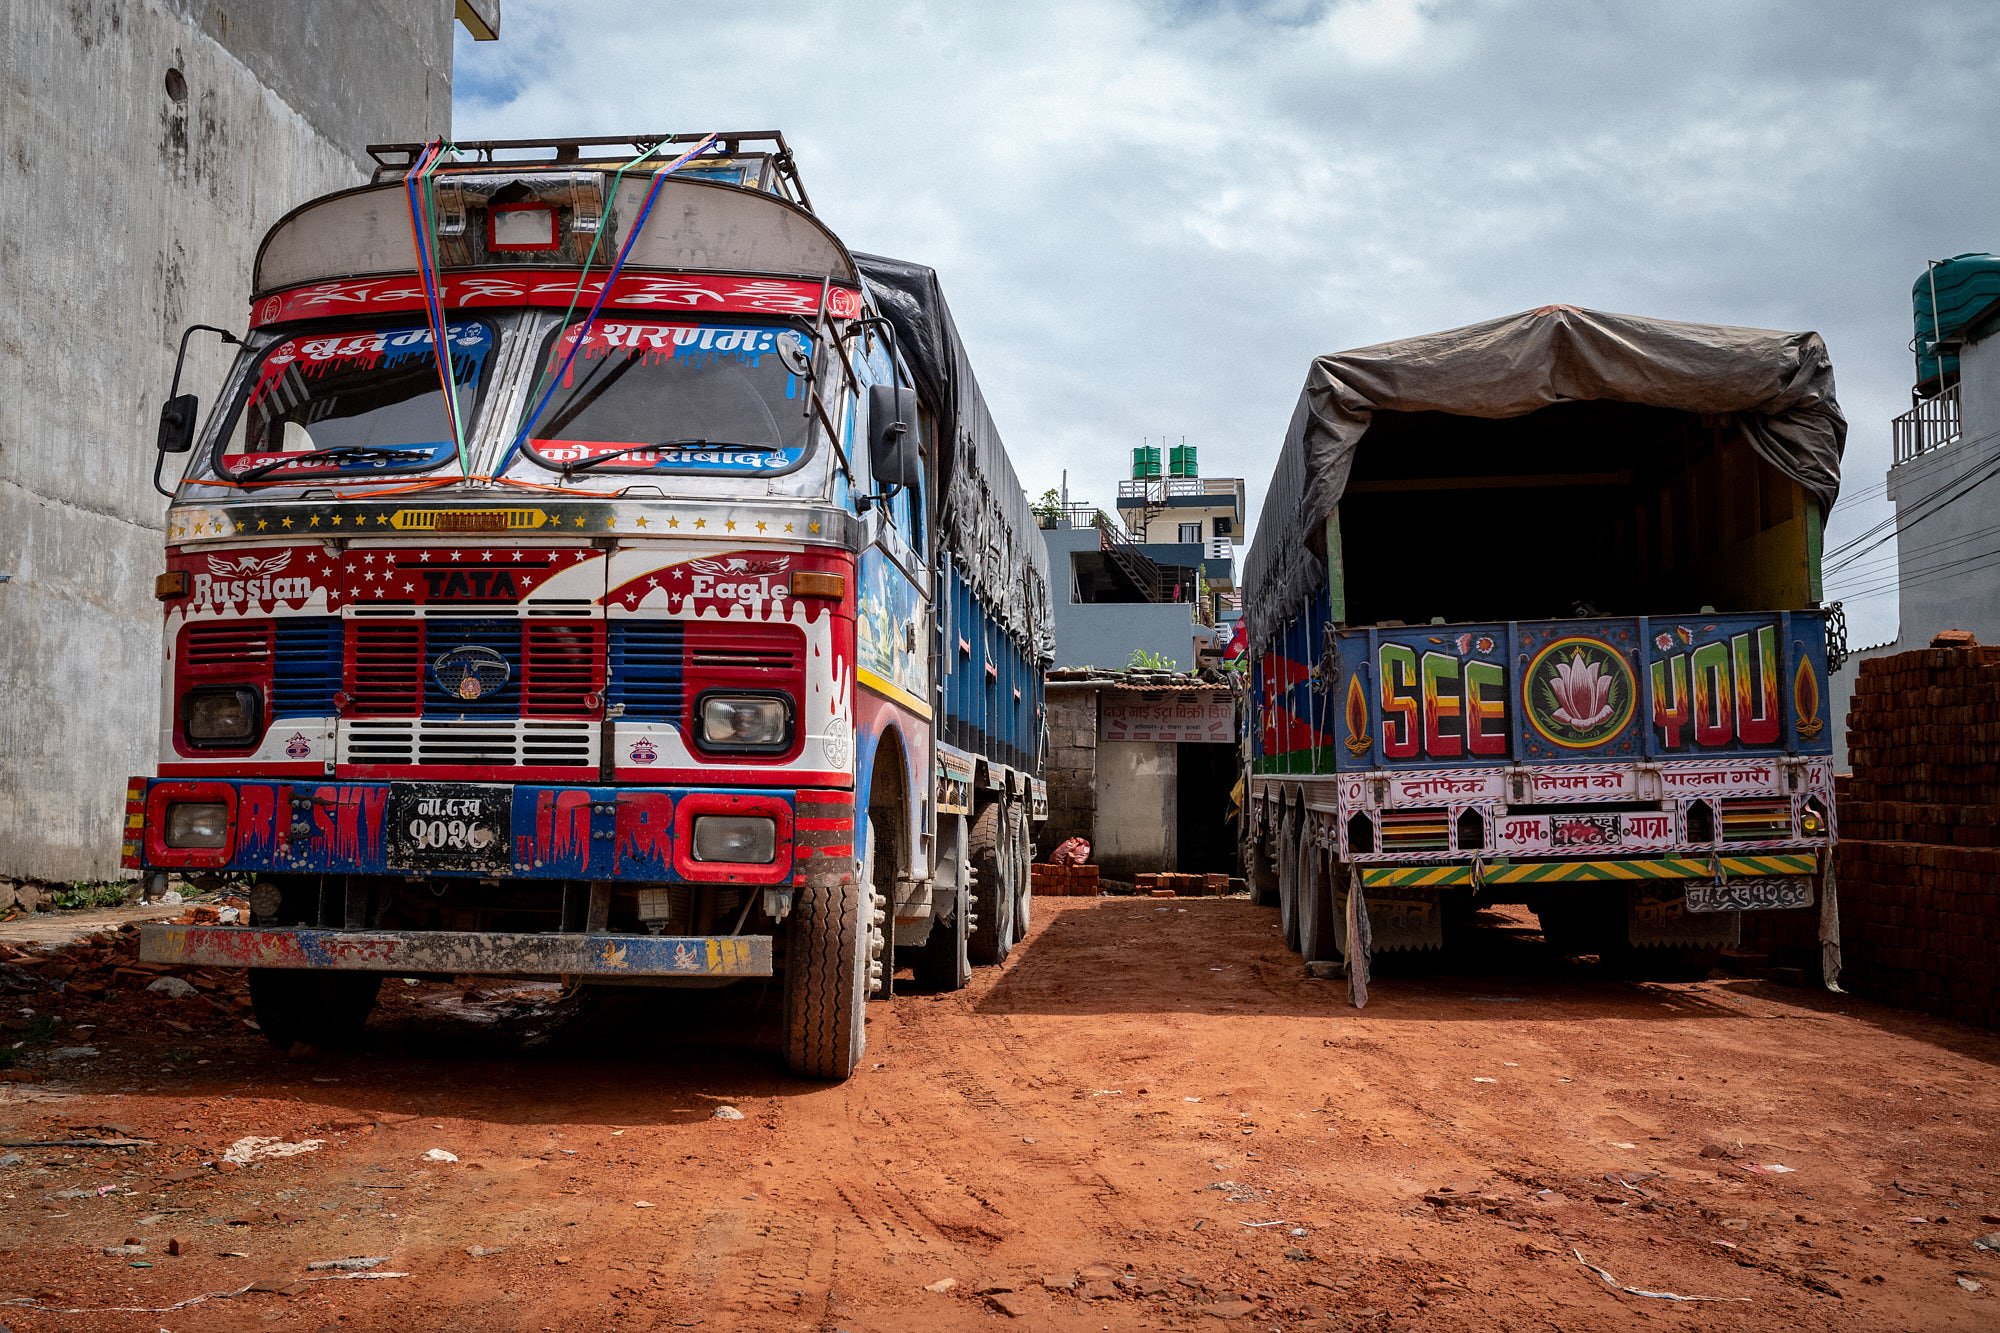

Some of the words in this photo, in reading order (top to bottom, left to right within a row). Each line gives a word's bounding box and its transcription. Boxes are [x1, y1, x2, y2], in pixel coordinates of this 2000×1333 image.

[539, 443, 596, 461] को
[194, 572, 314, 605] Russian
[423, 571, 518, 597] TATA
[691, 575, 789, 604] Eagle
[1378, 642, 1507, 759] SEE
[1650, 625, 1781, 749] YOU
[1663, 771, 1727, 788] पालना
[234, 784, 390, 868] RISKY
[1505, 820, 1541, 845] शुभ
[1628, 816, 1668, 840] यात्रा
